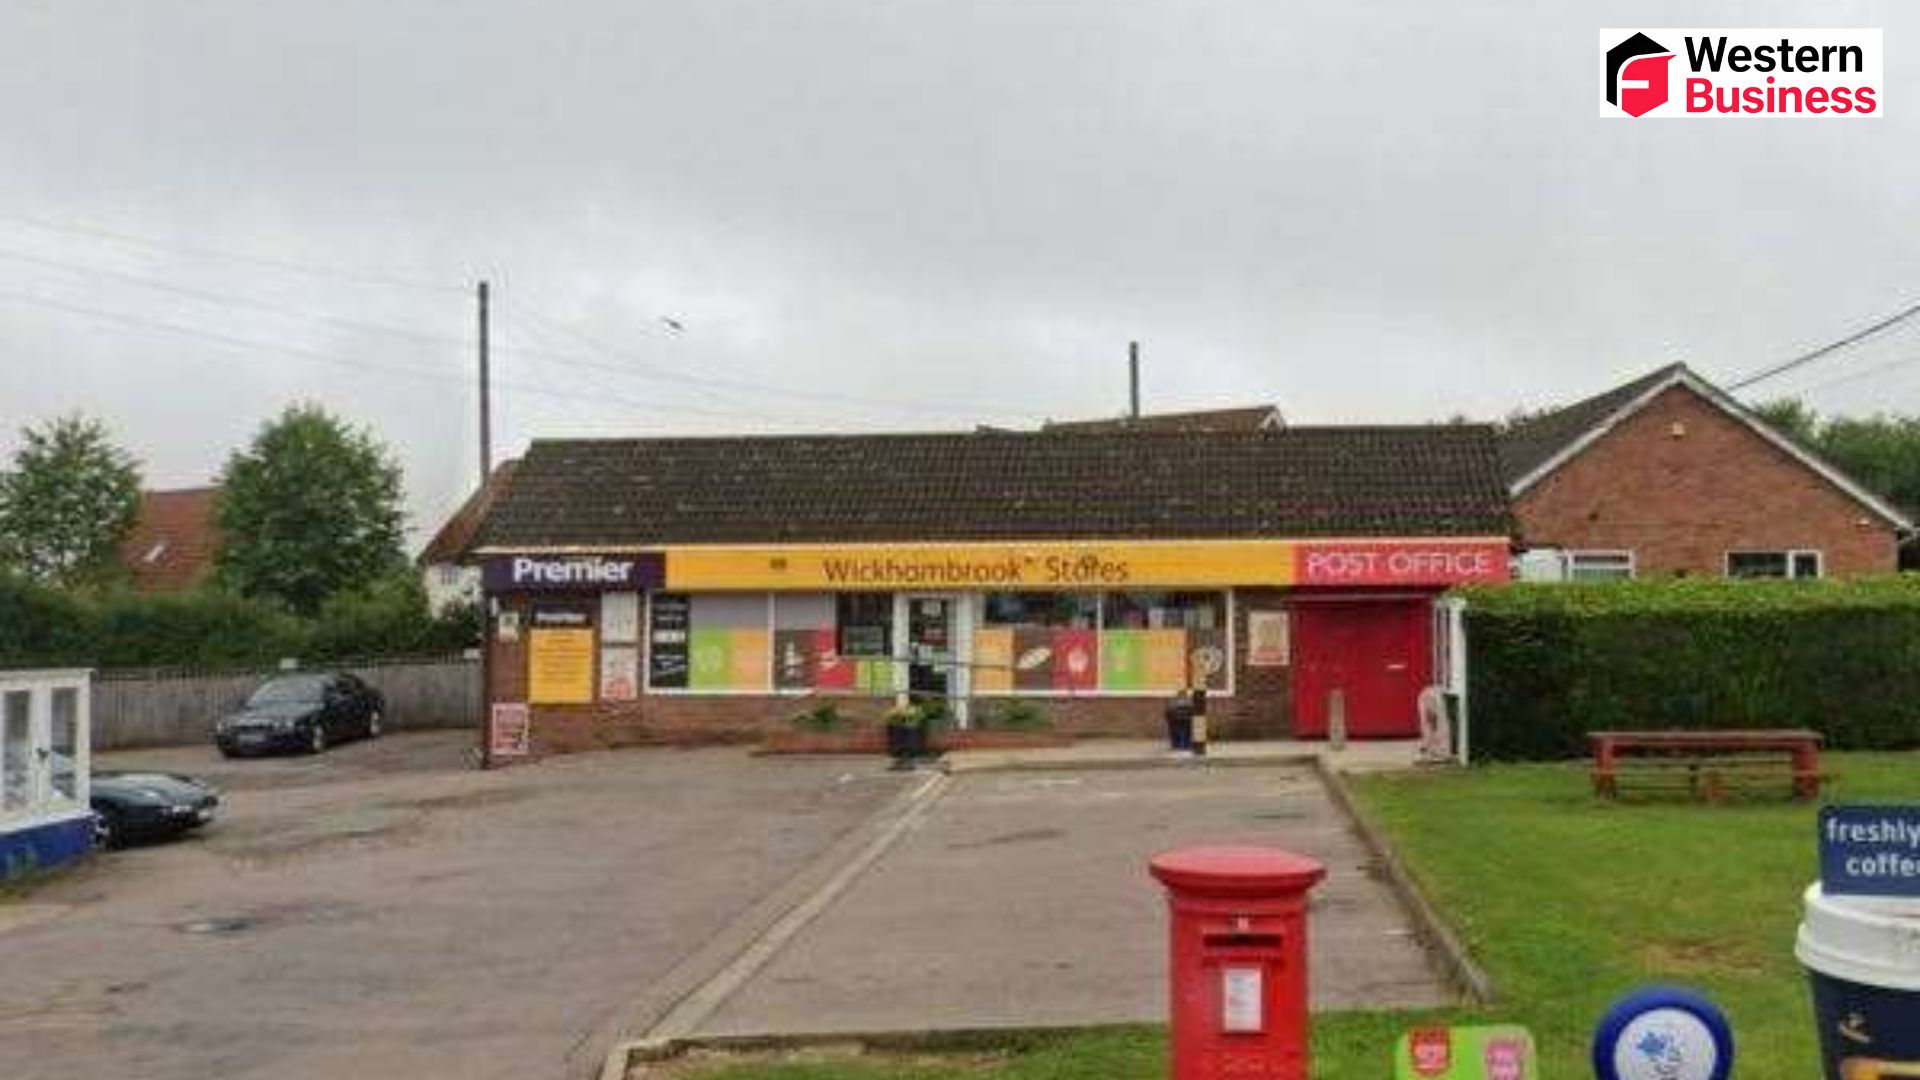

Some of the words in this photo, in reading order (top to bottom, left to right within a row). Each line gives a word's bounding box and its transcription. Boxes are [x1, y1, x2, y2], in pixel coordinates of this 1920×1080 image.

[513, 556, 635, 583] Premier
[822, 557, 1024, 584] Wickhambrook
[1046, 555, 1129, 583] Stores
[1307, 552, 1379, 575] POST
[1388, 551, 1491, 575] OFFICE
[1826, 817, 1920, 849] freshly
[1845, 853, 1920, 877] coffe
